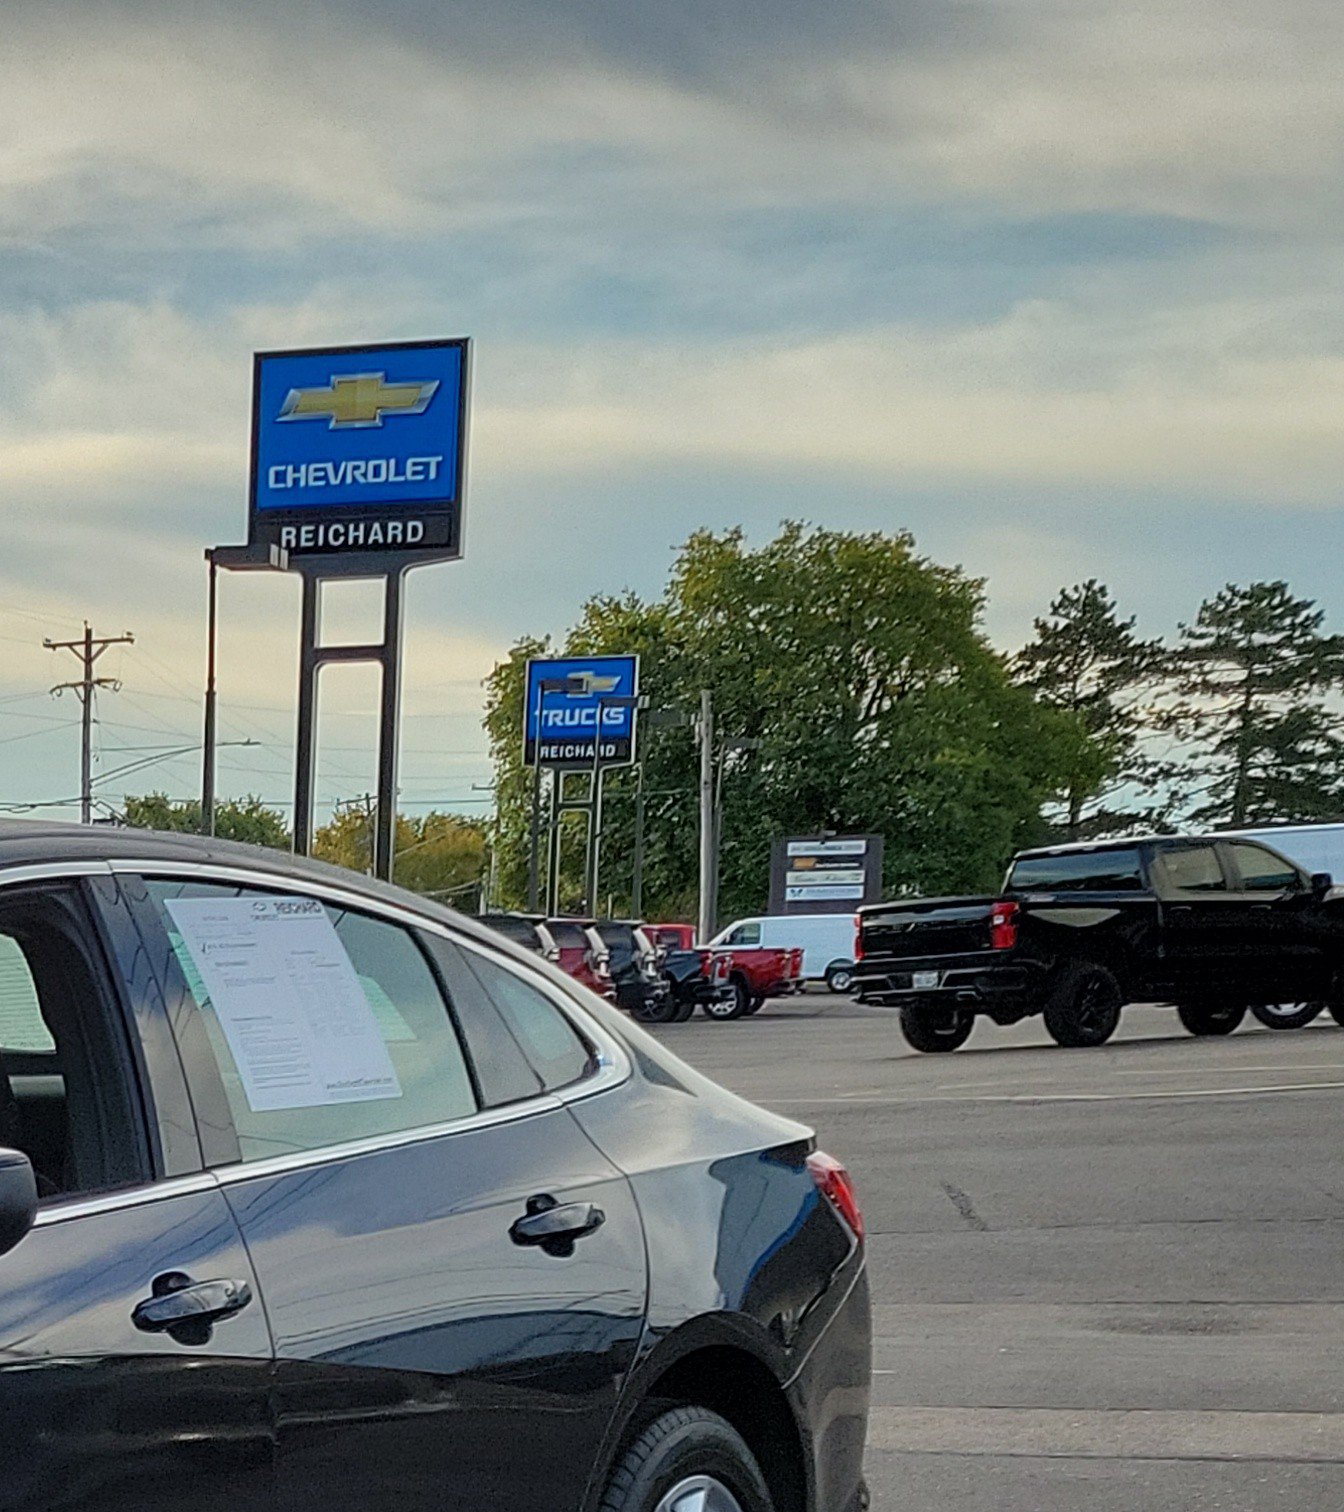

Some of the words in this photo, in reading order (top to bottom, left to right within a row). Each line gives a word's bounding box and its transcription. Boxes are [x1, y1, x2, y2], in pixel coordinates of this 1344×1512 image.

[268, 455, 443, 489] CHEVROLET
[281, 520, 424, 548] REICHARD
[534, 706, 625, 727] TRUCKS
